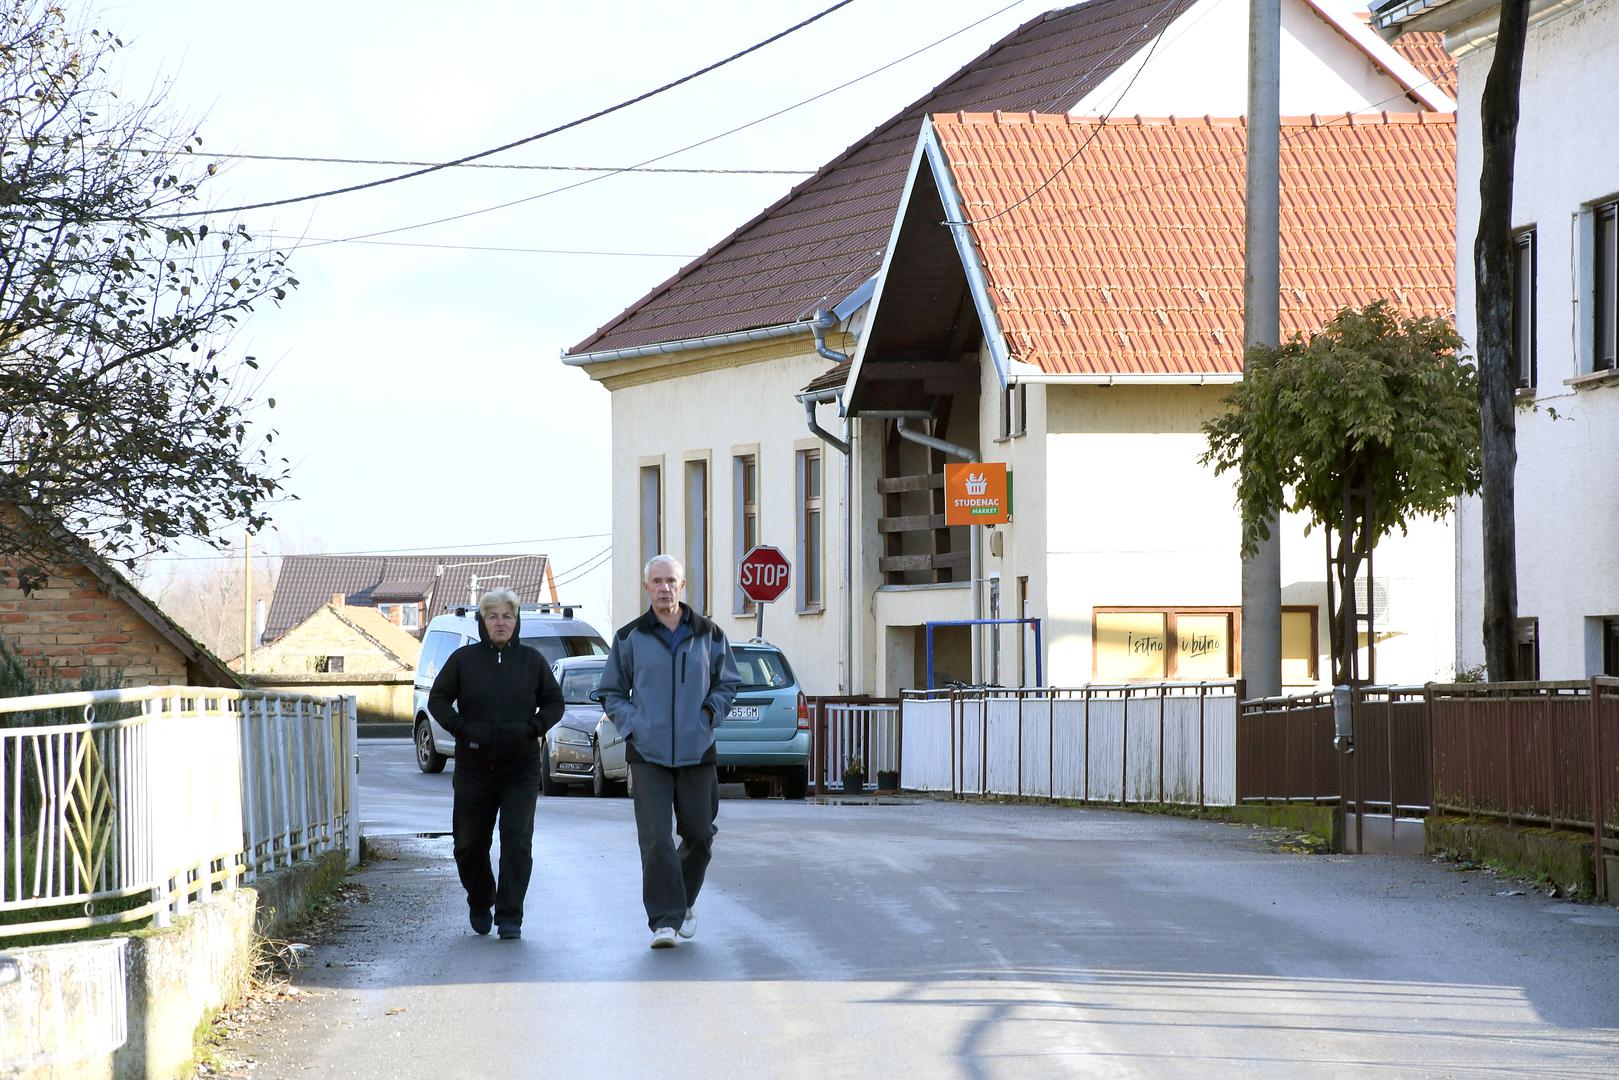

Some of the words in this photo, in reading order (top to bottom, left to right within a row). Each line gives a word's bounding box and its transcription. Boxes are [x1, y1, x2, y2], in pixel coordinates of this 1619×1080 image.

[954, 498, 999, 507] STUDENAC
[742, 563, 787, 586] STOP
[1134, 636, 1163, 656] sitno
[1190, 633, 1220, 655] bitno
